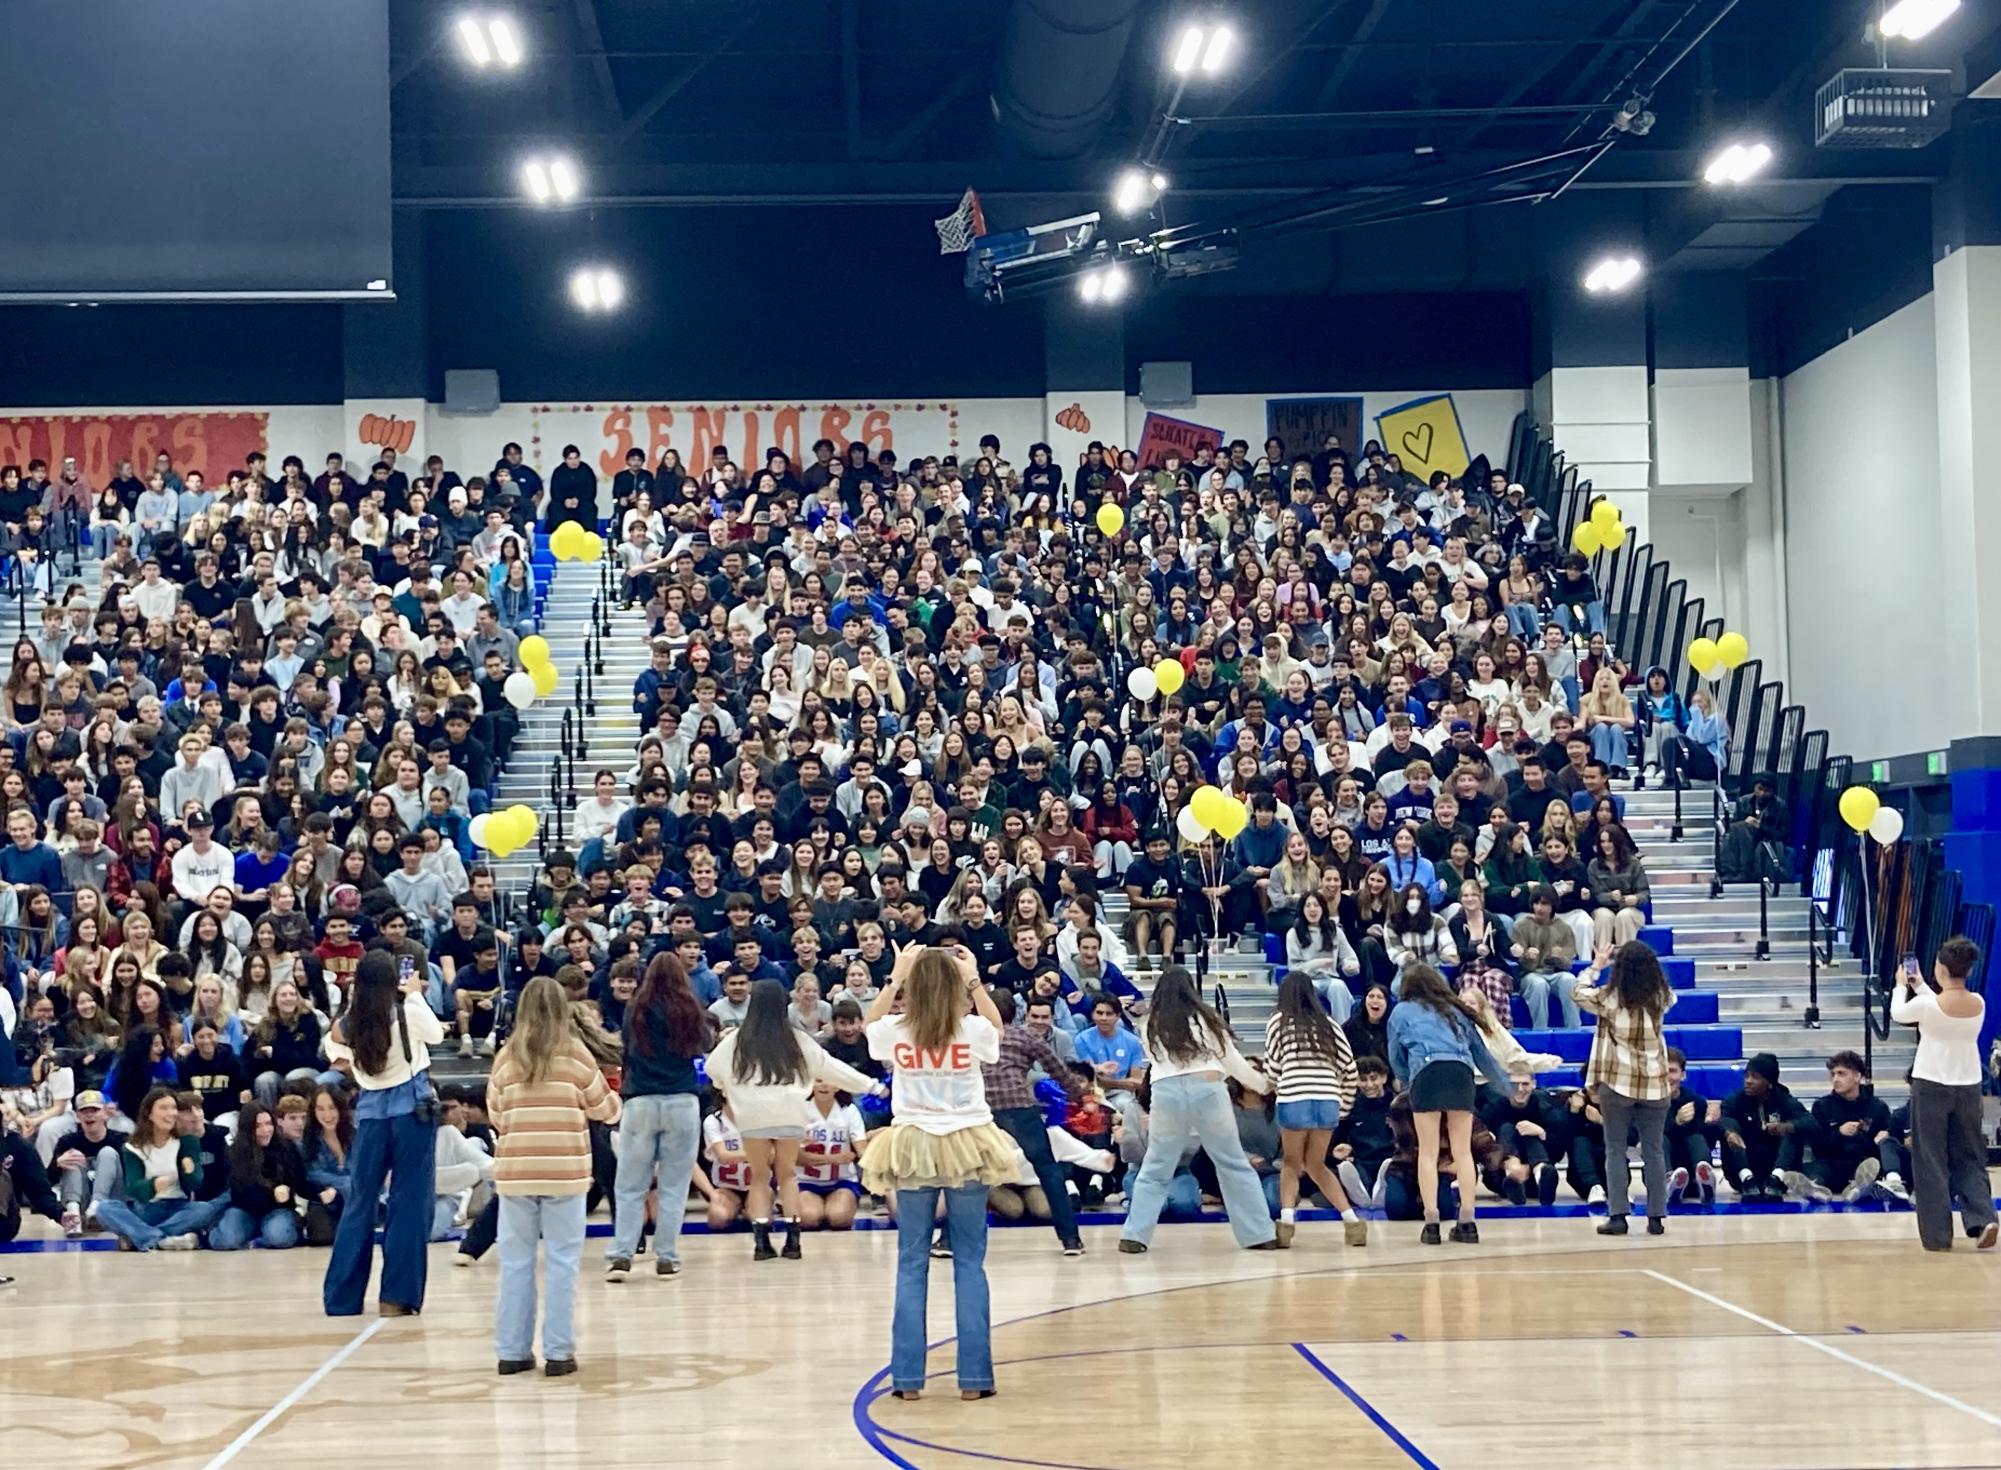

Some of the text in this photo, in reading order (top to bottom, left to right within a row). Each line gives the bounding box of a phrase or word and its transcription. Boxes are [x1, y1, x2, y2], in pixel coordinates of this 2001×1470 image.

[600, 405, 894, 477] SENIORS
[1361, 839, 1379, 848] LOS
[894, 1043, 971, 1070] GIVE
